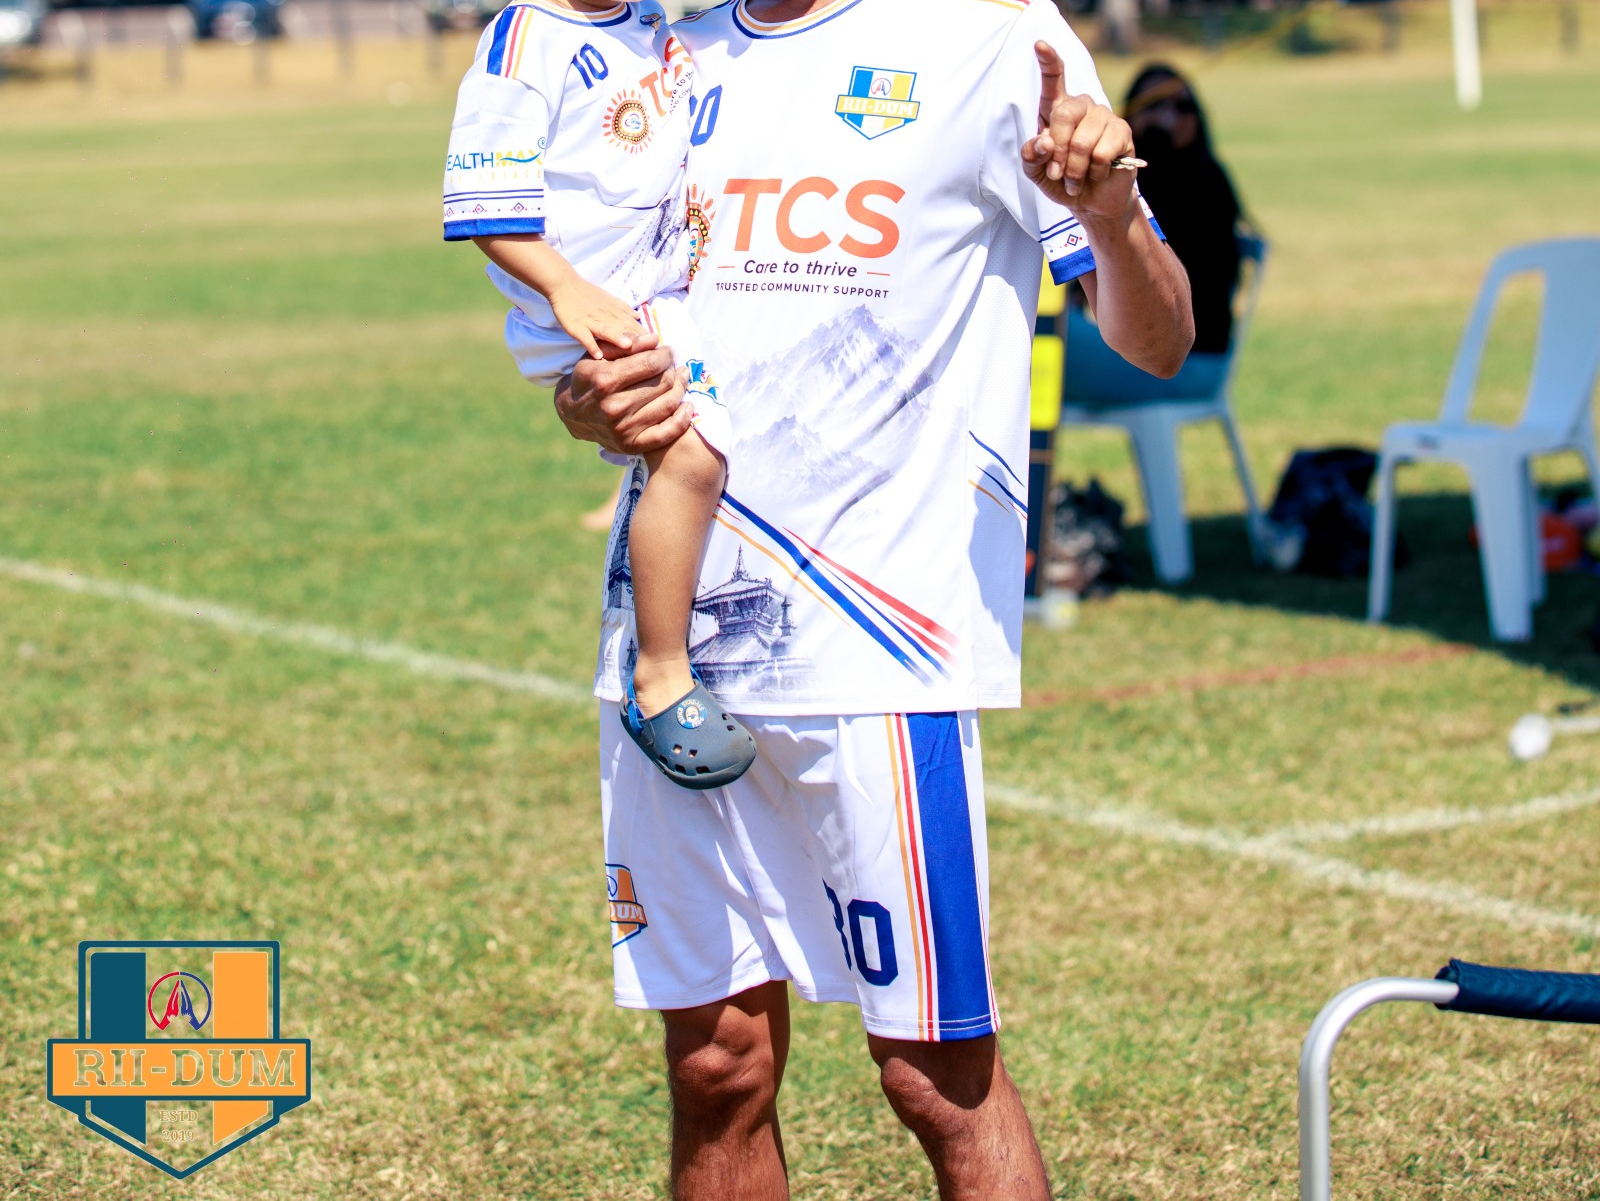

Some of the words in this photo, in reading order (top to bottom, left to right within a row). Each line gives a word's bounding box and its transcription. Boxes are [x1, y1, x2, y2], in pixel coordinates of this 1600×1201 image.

[571, 43, 608, 90] 10
[842, 98, 914, 116] RII-DUM
[447, 149, 542, 171] EALTHMAX
[723, 176, 905, 259] TCS
[744, 260, 777, 274] Care
[783, 261, 799, 274] to
[806, 261, 857, 277] thrive
[716, 282, 759, 292] TRUSTED
[760, 283, 829, 294] COMMUNITY
[833, 285, 889, 298] SUPPORT
